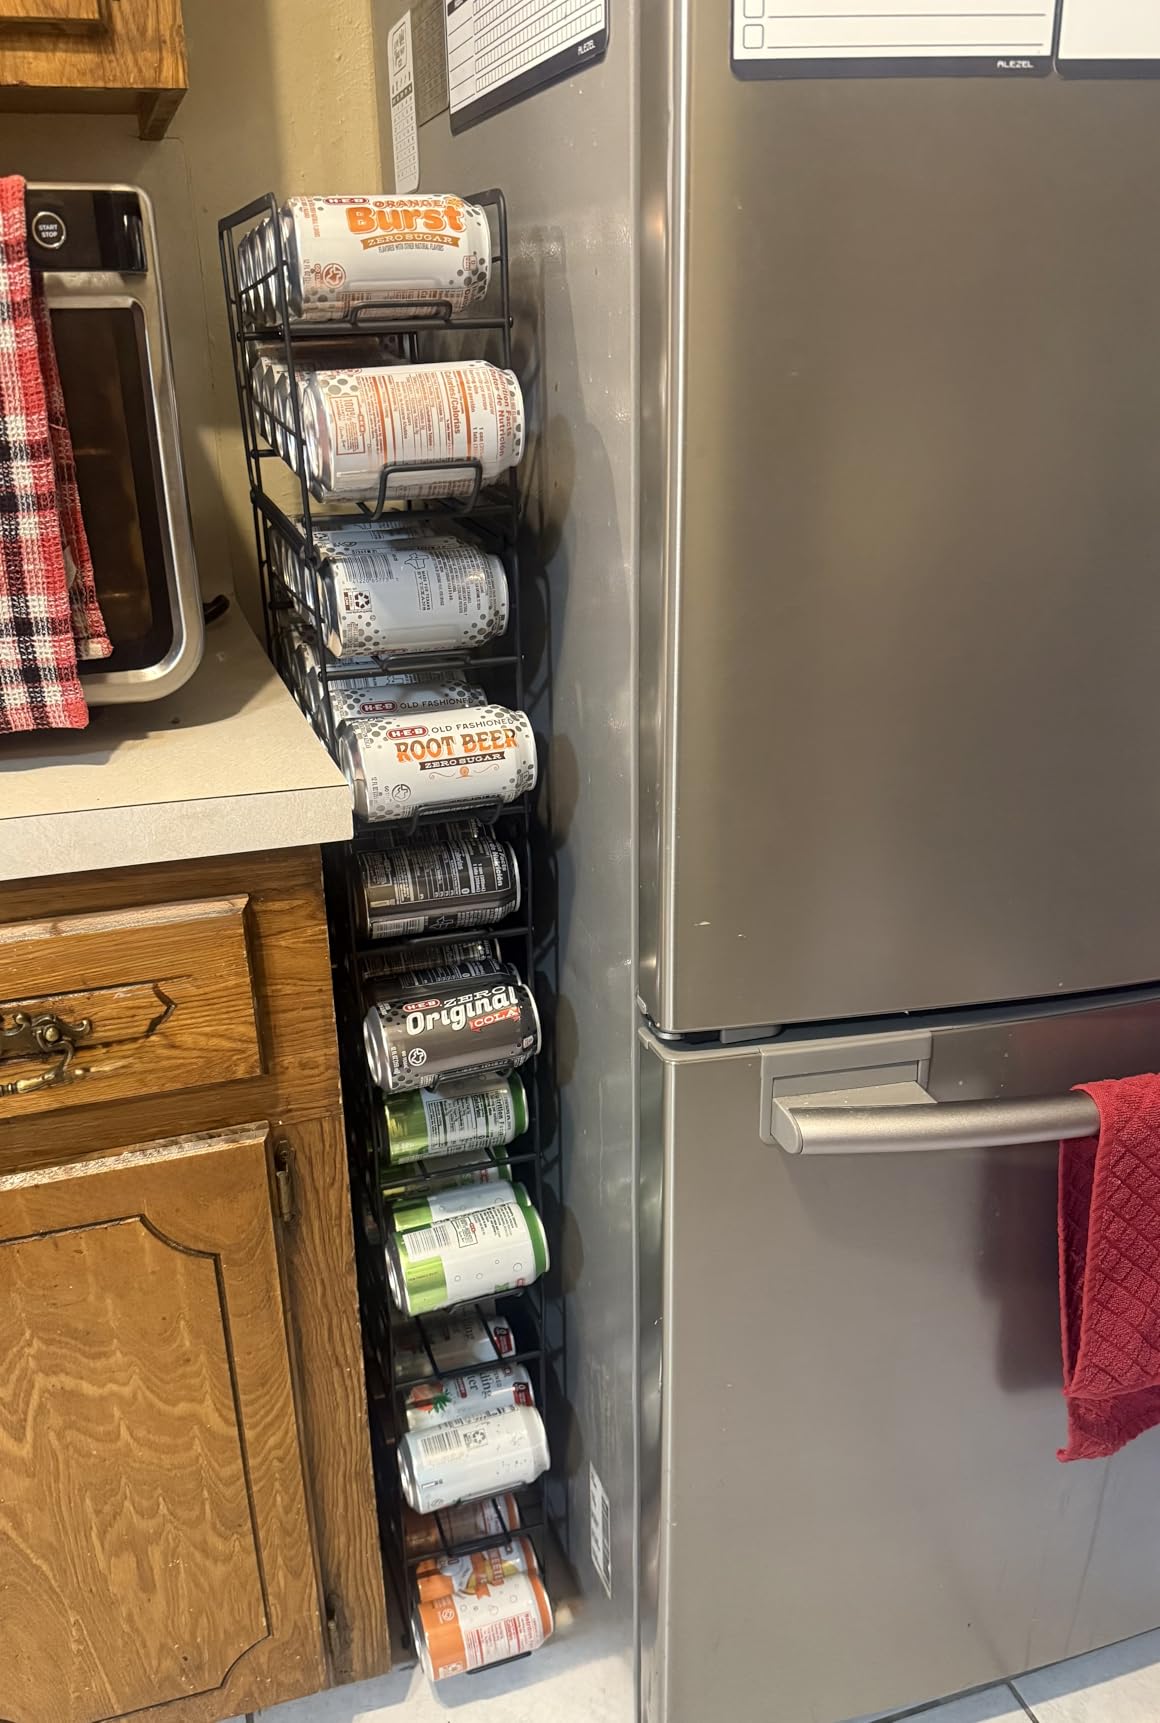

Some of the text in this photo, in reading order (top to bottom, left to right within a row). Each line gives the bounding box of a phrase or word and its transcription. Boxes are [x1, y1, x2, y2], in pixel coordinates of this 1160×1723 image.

[997, 60, 1034, 69] ALEZEL
[372, 199, 444, 208] ORANGE
[345, 205, 467, 235] Burst
[367, 234, 453, 247] ZERO SUGAR
[417, 571, 426, 611] BY TEXANS
[400, 702, 419, 710] OLD
[422, 697, 475, 708] FASHIONED
[431, 725, 453, 734] OLD
[456, 718, 514, 730] FASHIONED
[394, 728, 518, 764] ROOT BEER
[424, 753, 502, 769] ZERO SUGAR
[444, 986, 506, 1008] ZERO
[406, 986, 518, 1036] Original
[474, 1010, 517, 1027] COLA
